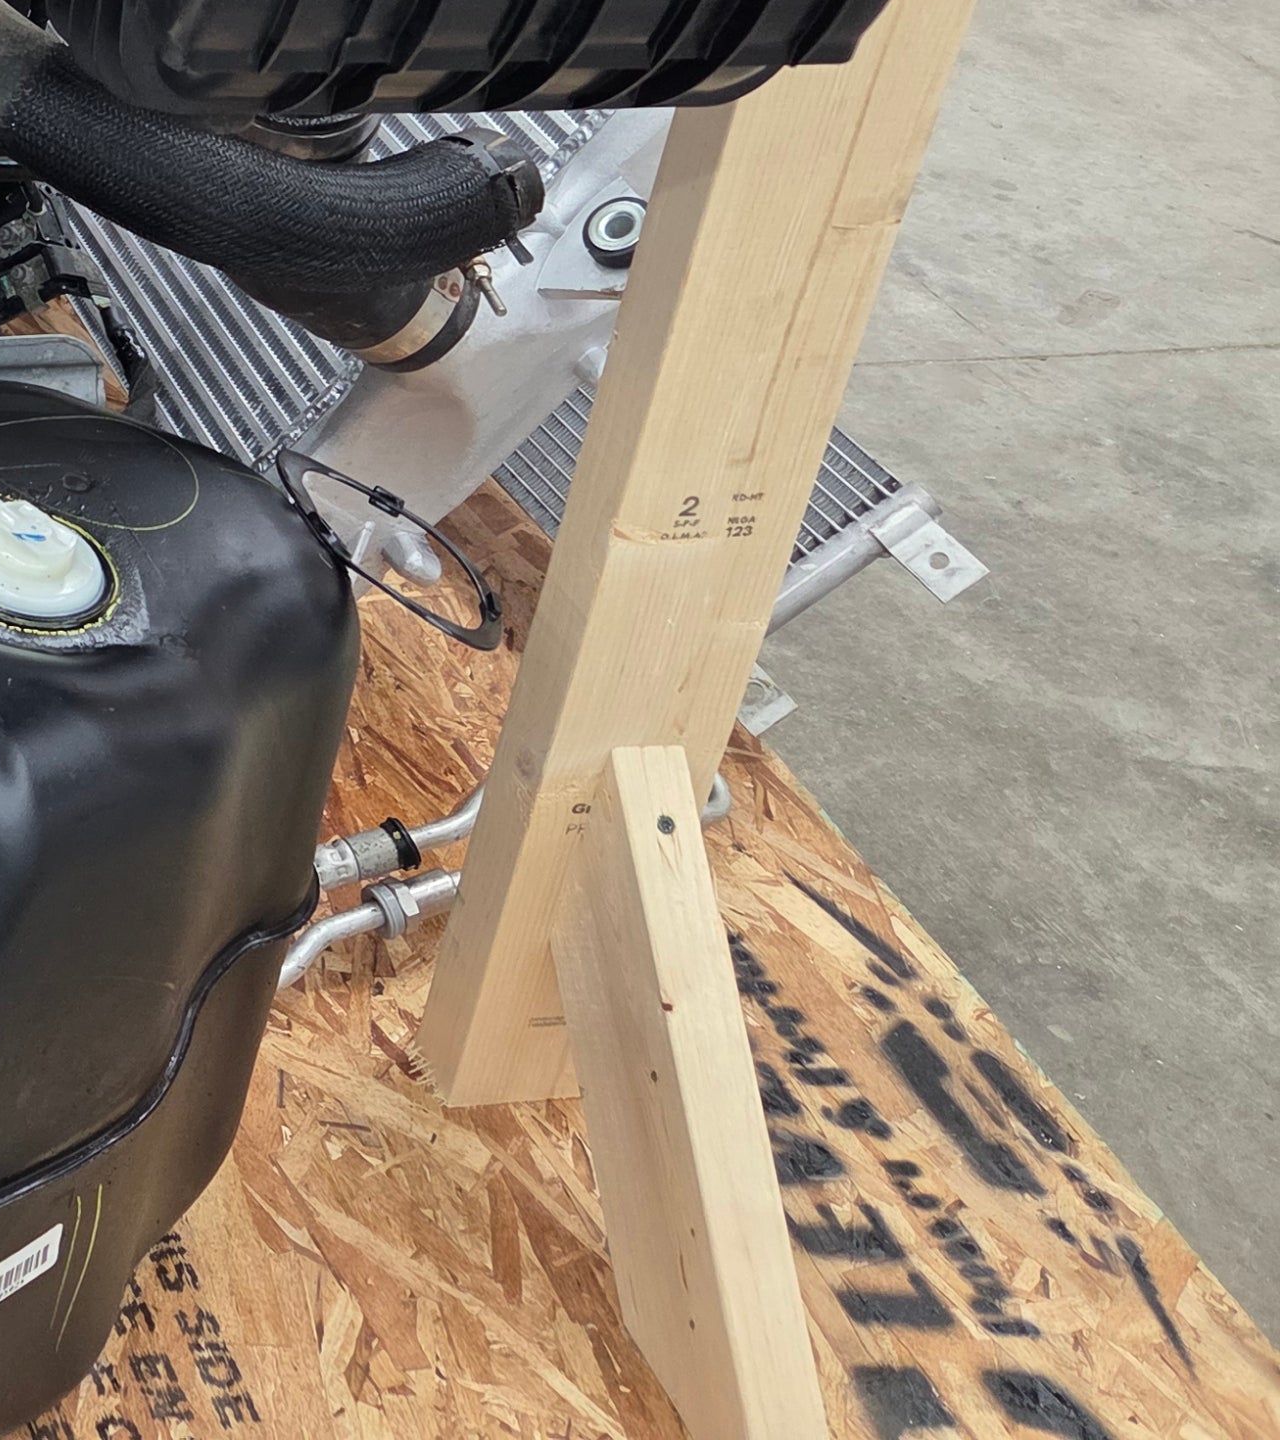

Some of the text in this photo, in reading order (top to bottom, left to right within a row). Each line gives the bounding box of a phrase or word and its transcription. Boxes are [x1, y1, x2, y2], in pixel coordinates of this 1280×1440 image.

[678, 495, 700, 517] 2
[726, 525, 754, 538] 123
[175, 1308, 261, 1431] SIDE
